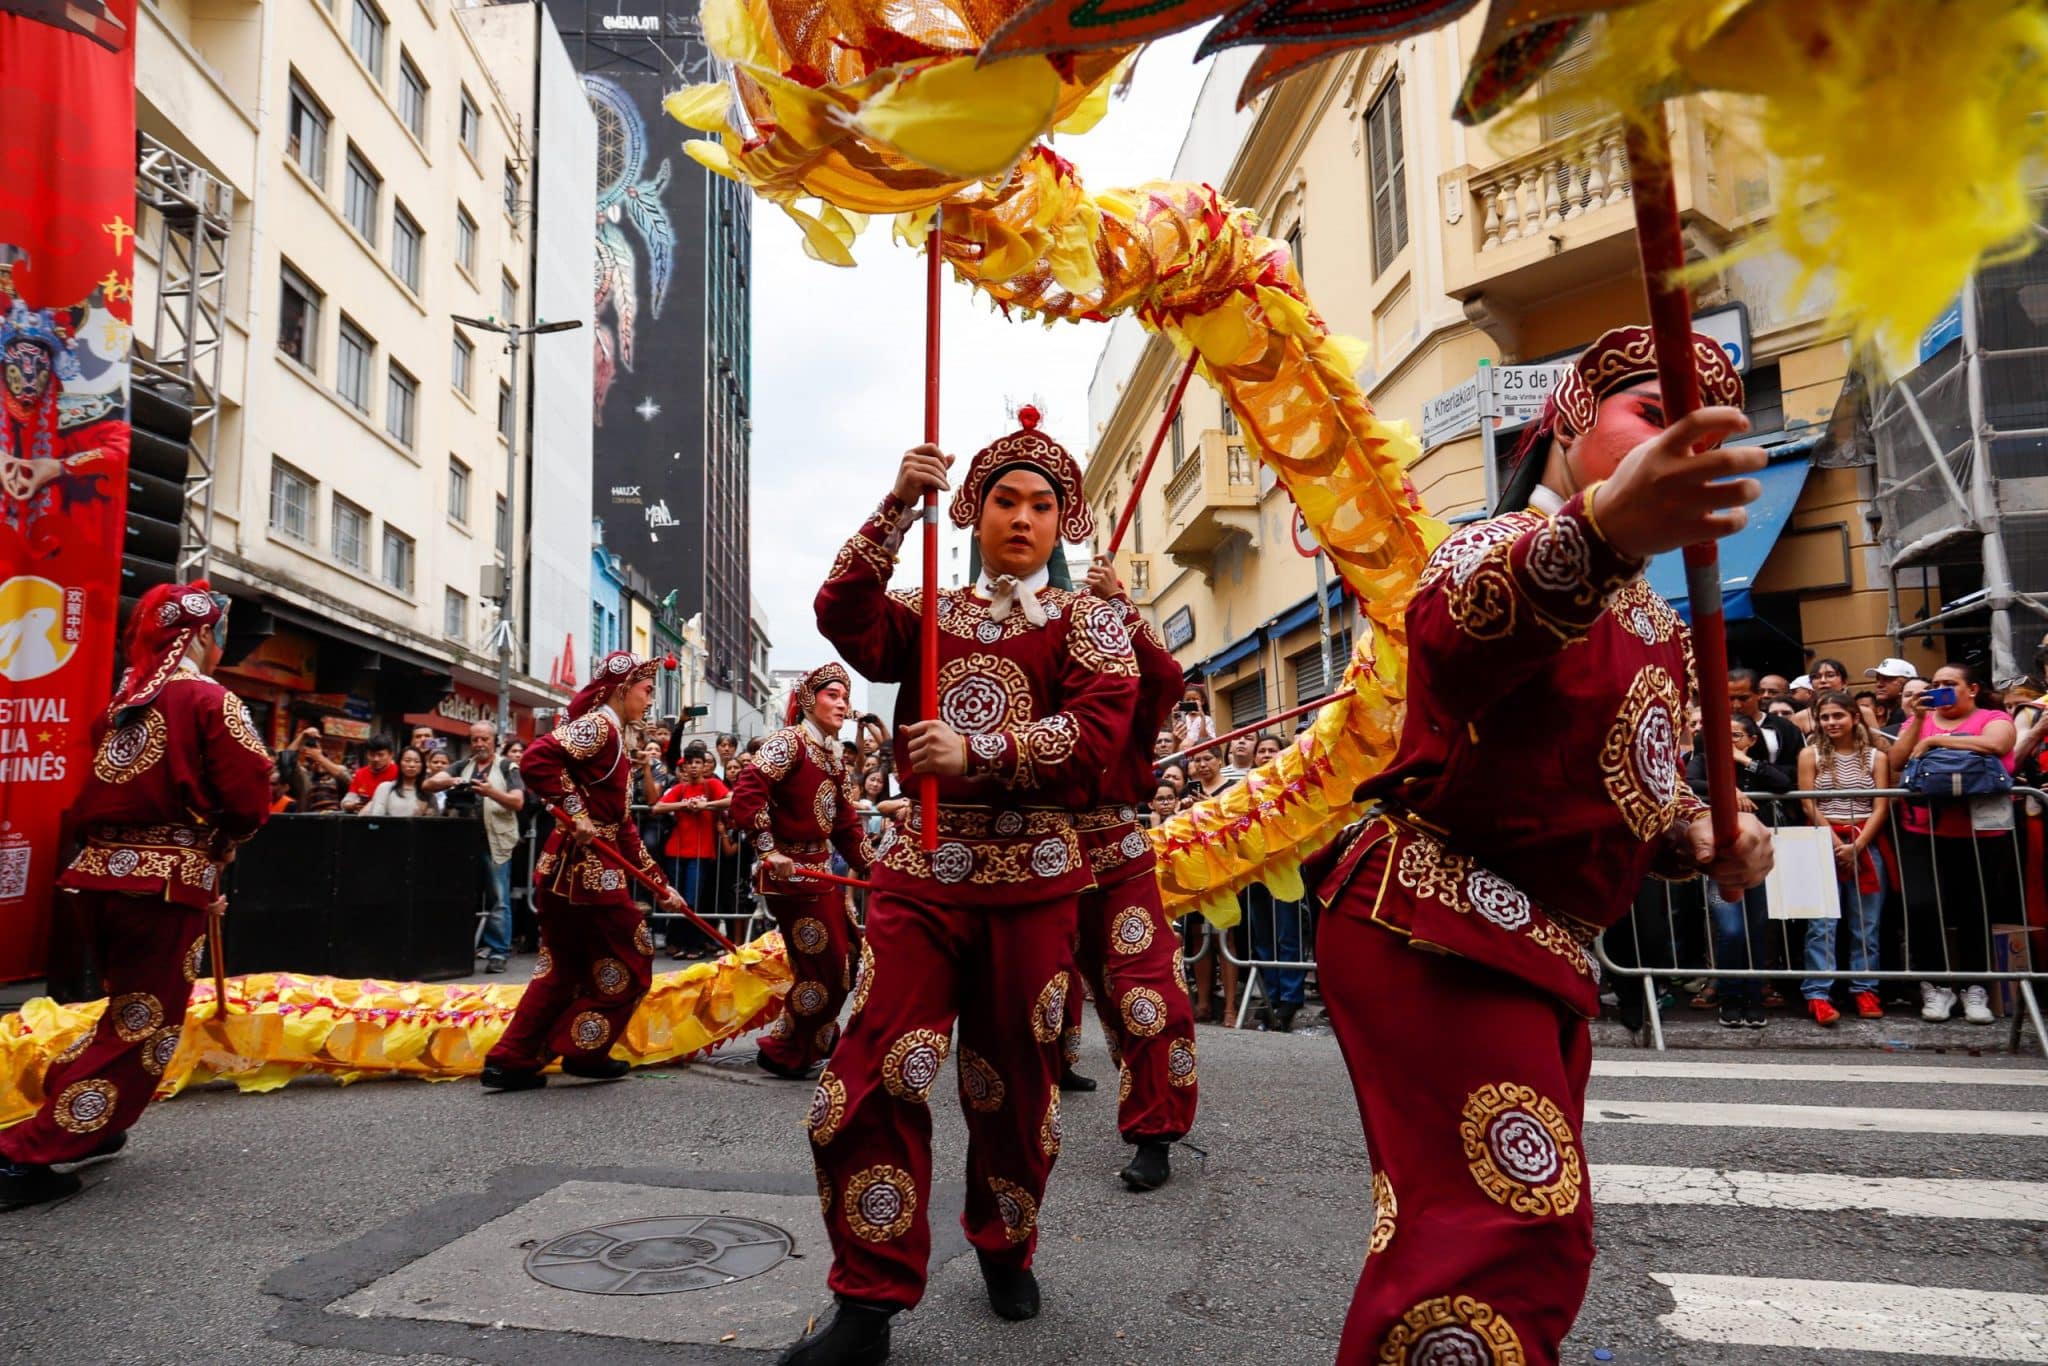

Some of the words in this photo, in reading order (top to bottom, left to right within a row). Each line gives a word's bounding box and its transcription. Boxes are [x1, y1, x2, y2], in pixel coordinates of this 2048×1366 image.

[1503, 370, 1523, 389] 25
[1529, 369, 1547, 388] de
[1424, 406, 1432, 424] A.
[1434, 384, 1476, 418] Kherlakian
